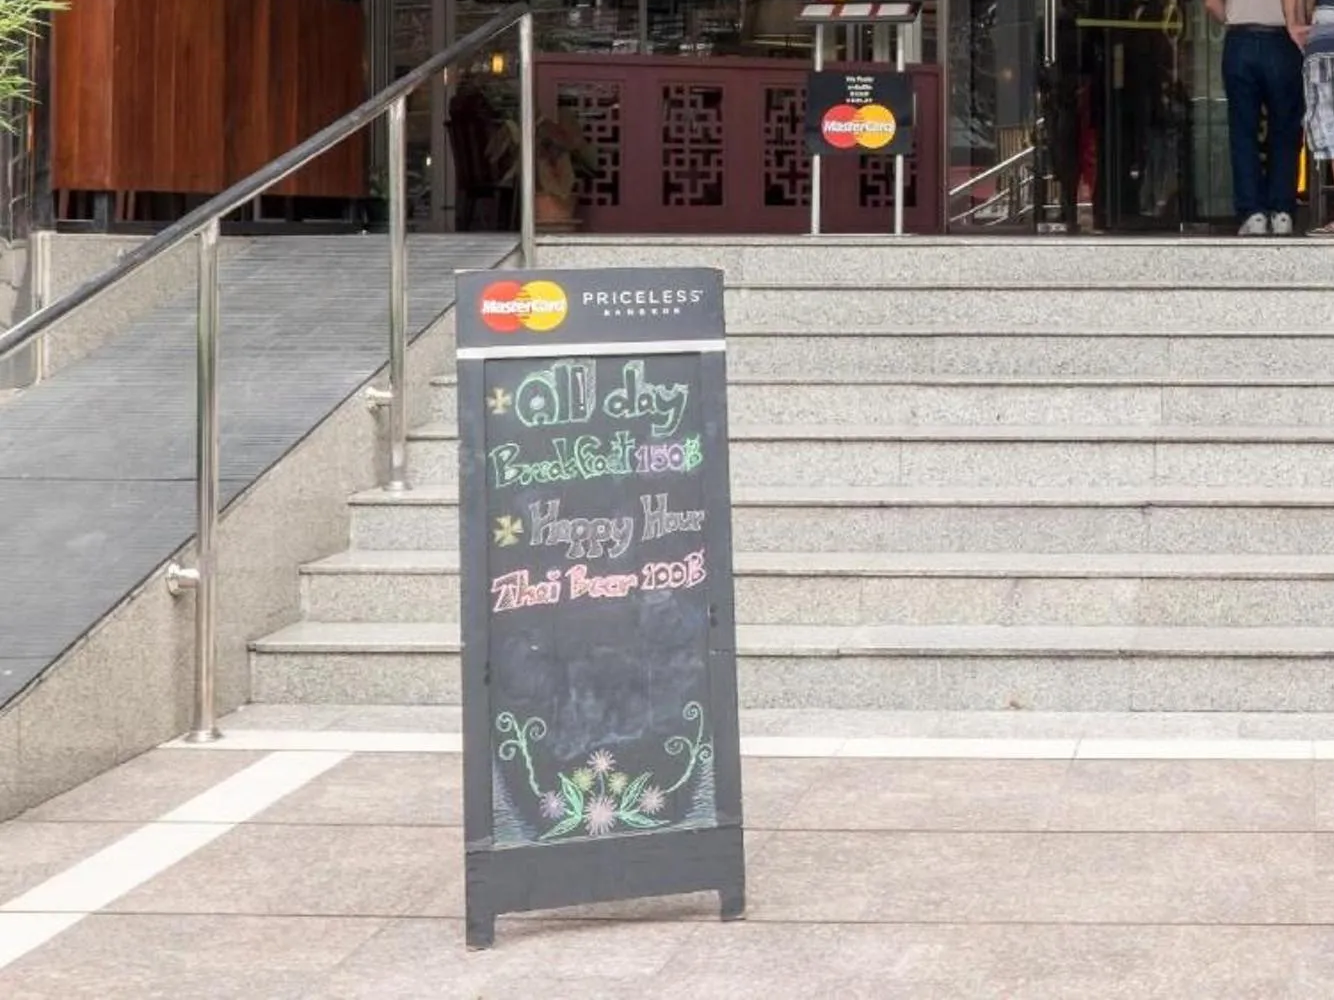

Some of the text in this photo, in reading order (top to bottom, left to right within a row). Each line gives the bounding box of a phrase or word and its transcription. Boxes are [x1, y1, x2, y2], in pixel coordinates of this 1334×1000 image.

[481, 289, 704, 315] MasterCard PRICELESS
[603, 360, 689, 437] day
[529, 492, 705, 559] Happy Hour
